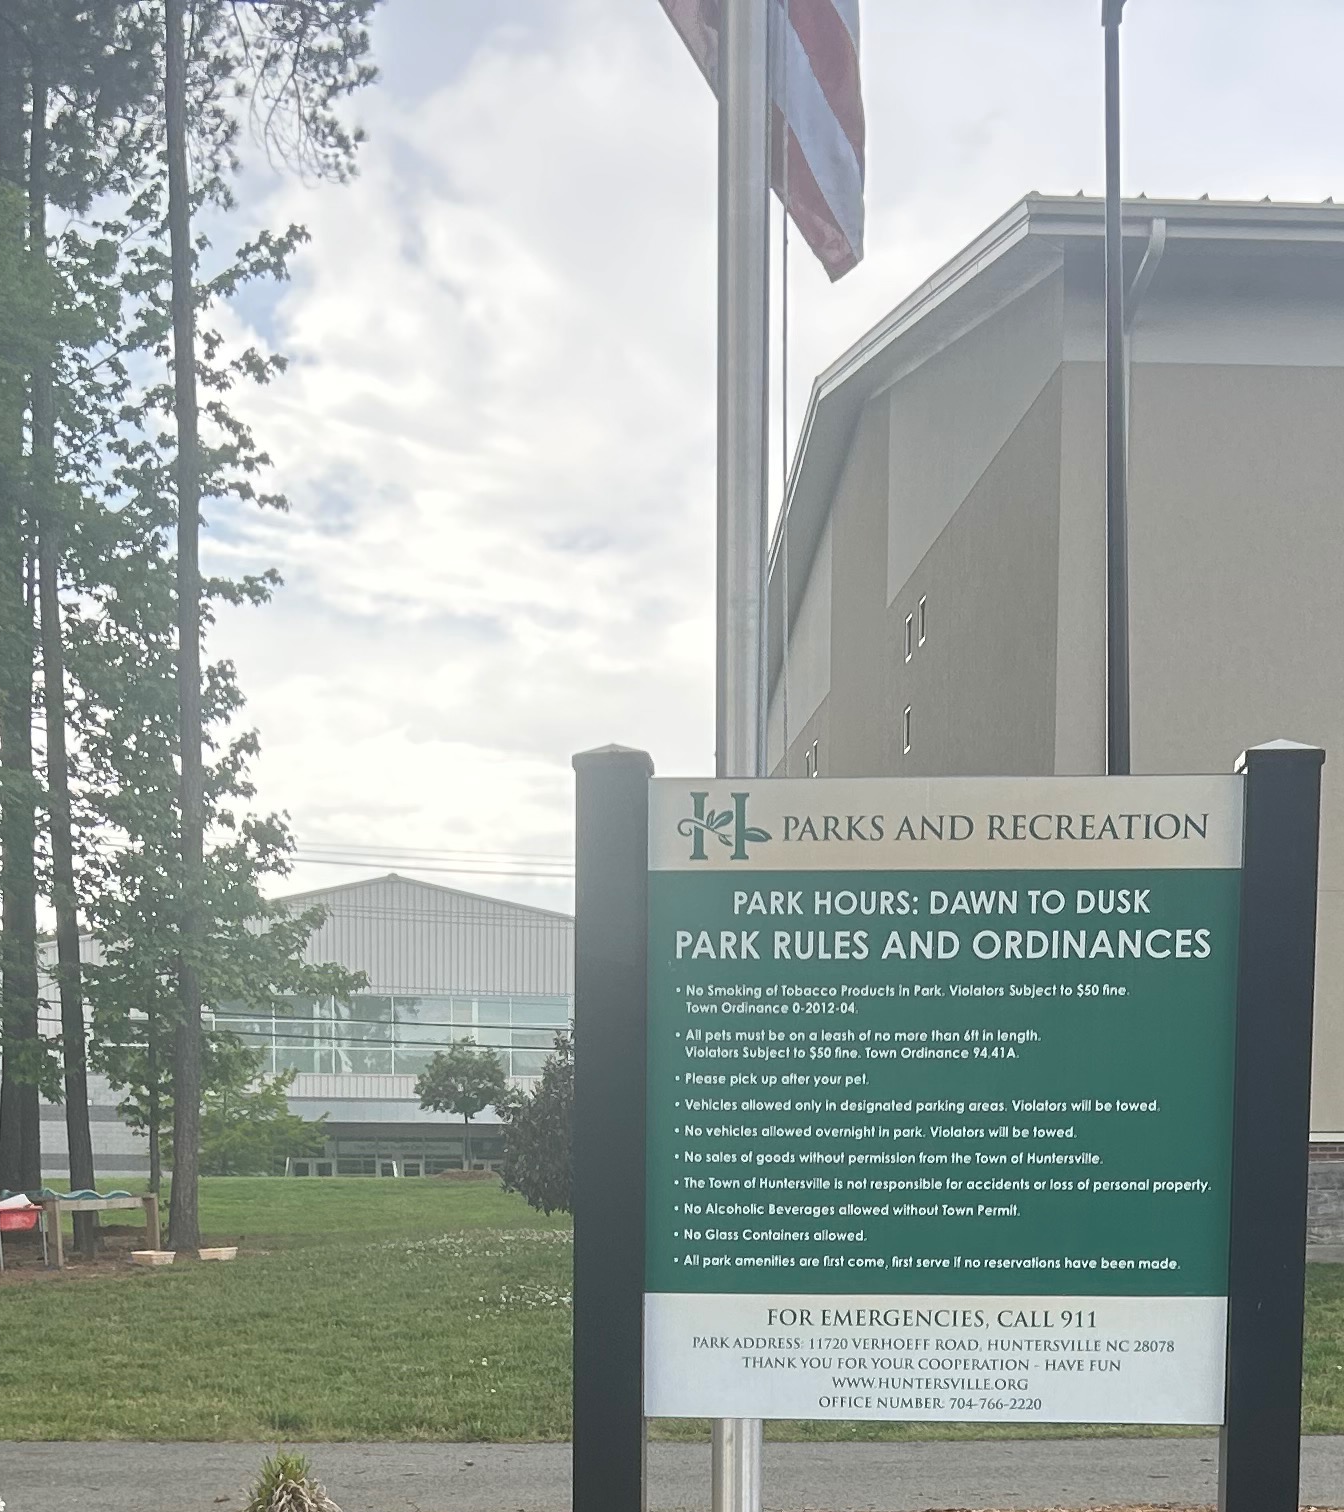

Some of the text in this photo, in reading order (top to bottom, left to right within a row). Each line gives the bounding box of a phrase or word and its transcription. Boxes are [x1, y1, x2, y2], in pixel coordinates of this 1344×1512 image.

[783, 814, 1210, 841] PARKS AND RECREATION
[733, 890, 1151, 914] PARK HOURS: DAWN TO DUSK
[676, 929, 1211, 959] PARK RULES AND ORDINANCES
[686, 984, 1130, 999] No Smoking of Tobacco Products in Park. Violators Subject to $50 fine.
[685, 1002, 718, 1013] Town
[721, 1002, 789, 1013] Ordinance
[685, 1029, 1042, 1043] All pets must be on a leash of no more than 6ft in length.
[684, 1046, 739, 1058] Violators
[742, 1047, 791, 1060] Subject
[793, 1048, 806, 1058] to
[809, 1047, 832, 1059] $50
[834, 1047, 862, 1058] fine.
[864, 1047, 897, 1058] Town
[900, 1047, 970, 1058] Ordinance
[685, 1073, 869, 1087] Please pick up after your pet.
[684, 1099, 1161, 1114] Vehicles allowed only in designated parking areas. Violators will be towed.
[684, 1125, 1078, 1140] No vehicles allowed overnight in park. Violators will be towed.
[684, 1151, 1104, 1165] No sales of goods without permission from the Town of Huntersville.
[683, 1177, 1212, 1193] The Town of Huntersville is not responsible for accidents or loss of personal property.
[684, 1203, 1021, 1217] No Alcoholic Beverages allowed without Town Permit.
[683, 1229, 868, 1241] No Glass Containers allowed.
[683, 1255, 1181, 1270] All park amenities are first come, first serve if no reservations have been made.
[767, 1309, 1097, 1329] FOR EMERGENCIES, CALL 911
[692, 1337, 730, 1349] PARK
[809, 1338, 848, 1350] 11720
[851, 1338, 931, 1350] VERHOEFF
[934, 1339, 983, 1351] ROAD,
[987, 1339, 1101, 1351] HUNTERSVILLE
[1105, 1340, 1130, 1352] NC
[1133, 1341, 1175, 1352] 28078
[741, 1356, 797, 1369] THANK
[800, 1357, 833, 1369] YOU
[837, 1357, 868, 1370] FOR
[870, 1358, 915, 1370] YOUR
[917, 1358, 1031, 1371] COOPERATION
[1044, 1359, 1085, 1371] HAVE
[1089, 1360, 1121, 1371] FUN
[831, 1377, 1029, 1390] WWW.HUNTERSVILLE.ORG
[818, 1396, 872, 1408] OFFICE
[949, 1398, 1042, 1410] 704-766-2220
